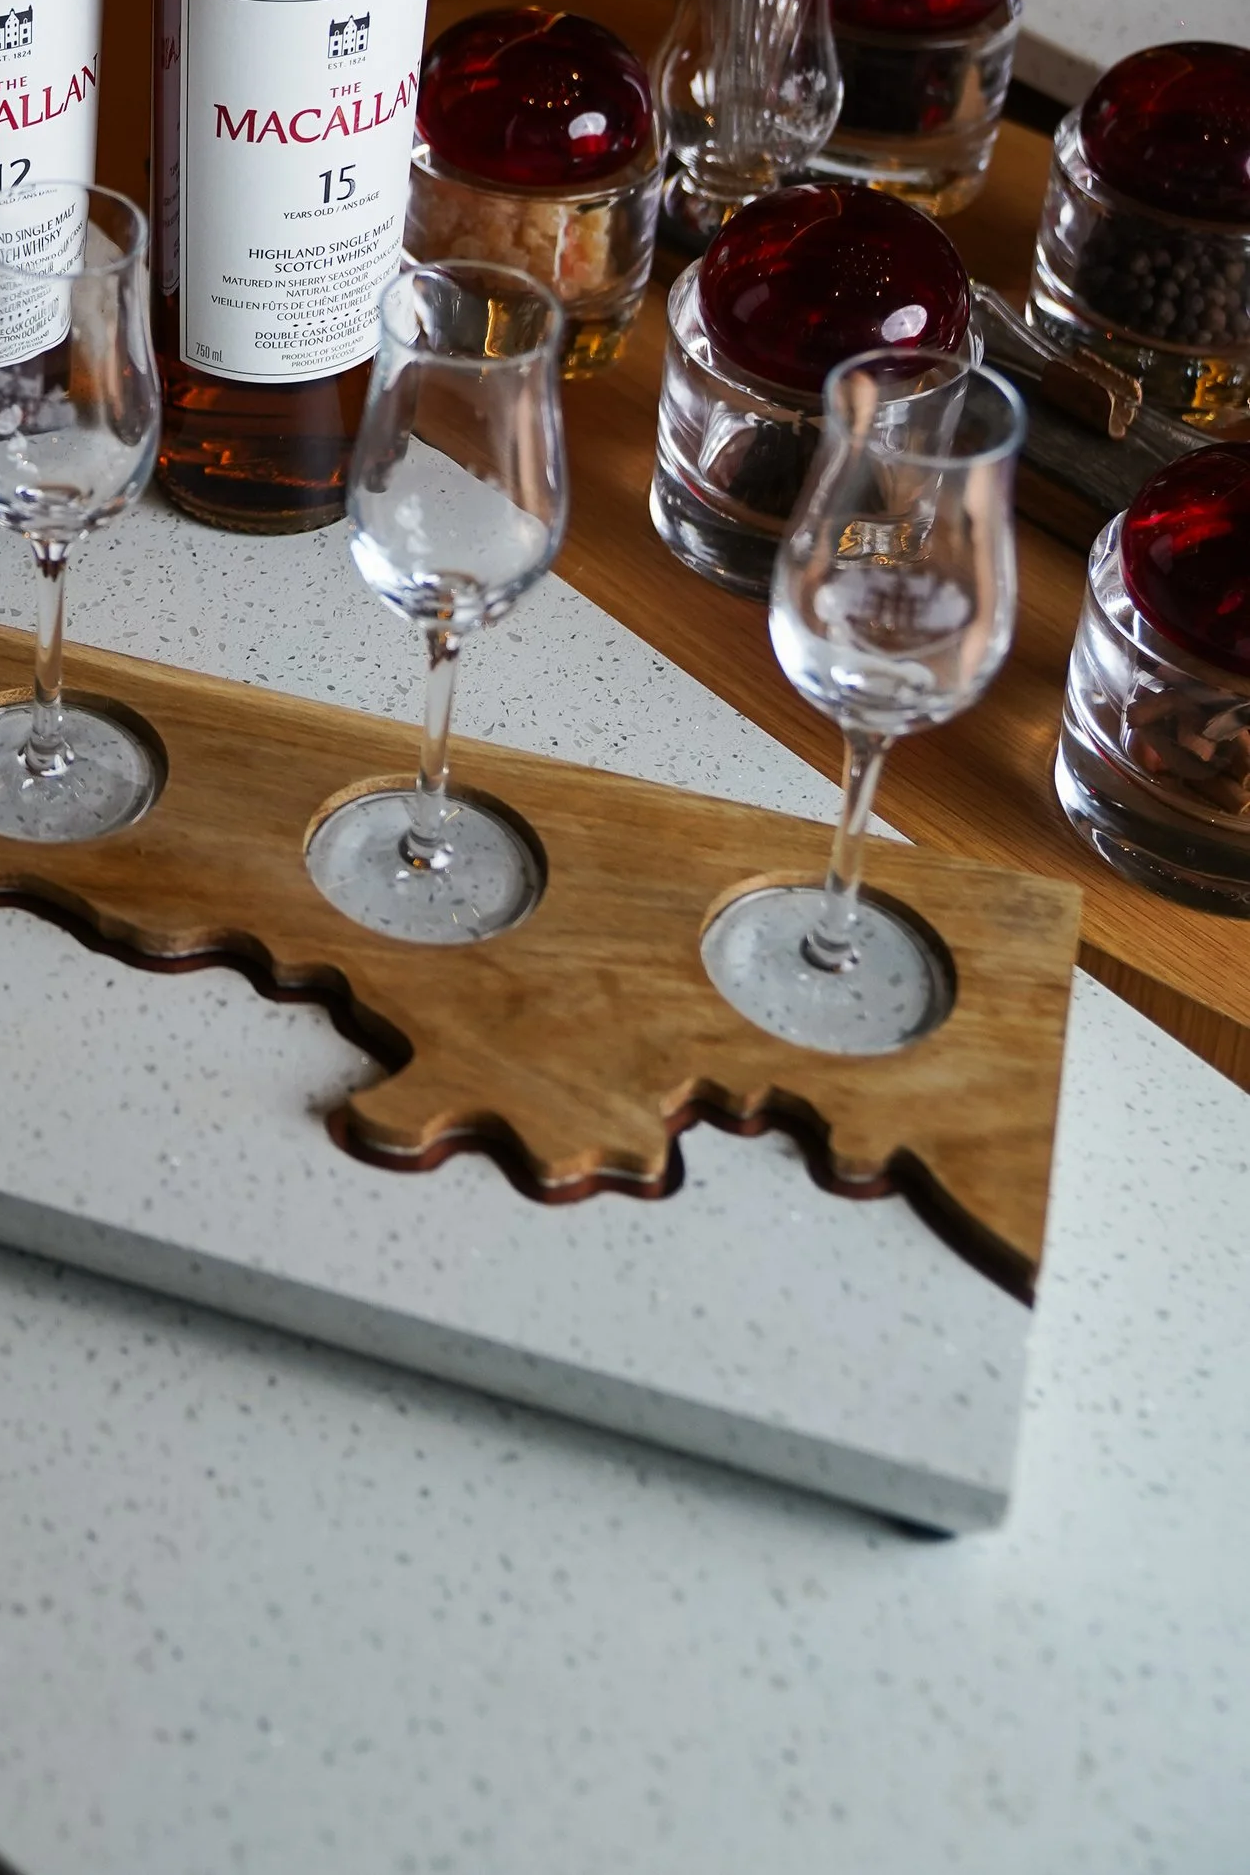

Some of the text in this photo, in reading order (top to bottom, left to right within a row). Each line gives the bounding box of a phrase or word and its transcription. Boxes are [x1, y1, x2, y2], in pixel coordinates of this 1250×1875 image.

[14, 49, 32, 59] 1824
[349, 56, 366, 66] 1824
[214, 59, 420, 144] MACALLAN
[330, 81, 362, 99] THE
[319, 164, 356, 204] 15
[15, 219, 54, 243] SINGLE
[55, 203, 76, 226] MALT
[283, 209, 312, 221] YEARS
[314, 207, 334, 218] OLD
[342, 201, 358, 213] ANS
[22, 227, 62, 258] WHISKY
[249, 215, 395, 260] HIGHLAND SINGLE MALT
[274, 257, 334, 273] SCOTCH
[337, 239, 380, 265] WHISKY
[222, 275, 273, 288] MATURED
[275, 279, 286, 288] IN
[288, 275, 327, 288] SHERRY
[328, 261, 372, 283] SEASONED
[286, 272, 368, 298] NATURAL COLOUR
[211, 295, 244, 309] VIEILLI
[246, 302, 260, 311] EN
[262, 300, 290, 311] FÛTS
[291, 301, 305, 311] DE
[307, 294, 340, 307] CHÊNE
[276, 309, 325, 321] COULEUR
[327, 291, 372, 315] NATURELLE
[254, 313, 381, 350] COLLECTION DOUBLE CASK
[255, 304, 382, 341] DOUBLE CASK COLLECTION
[195, 342, 224, 363] 750 mL
[281, 351, 318, 361] PRODUCT
[319, 347, 330, 356] OF
